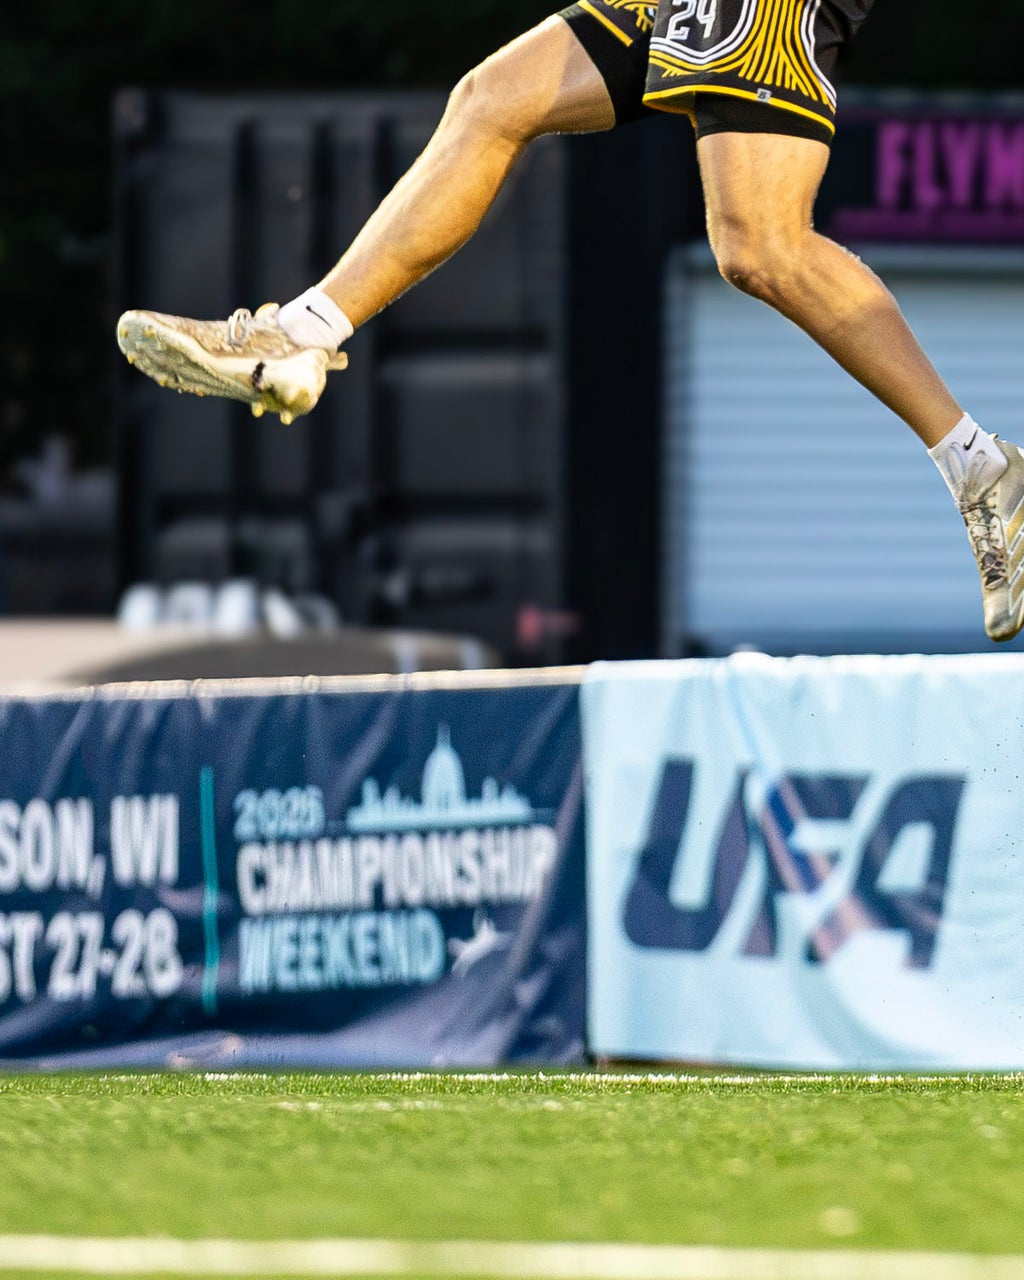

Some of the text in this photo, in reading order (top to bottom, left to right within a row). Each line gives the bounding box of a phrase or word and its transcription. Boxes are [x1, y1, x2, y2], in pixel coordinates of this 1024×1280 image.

[110, 793, 180, 887] WI
[237, 825, 557, 915] CHAMPIONSHIP
[622, 756, 969, 971] UFA
[46, 908, 183, 1001] 27-28
[238, 910, 446, 994] WEEKEND
